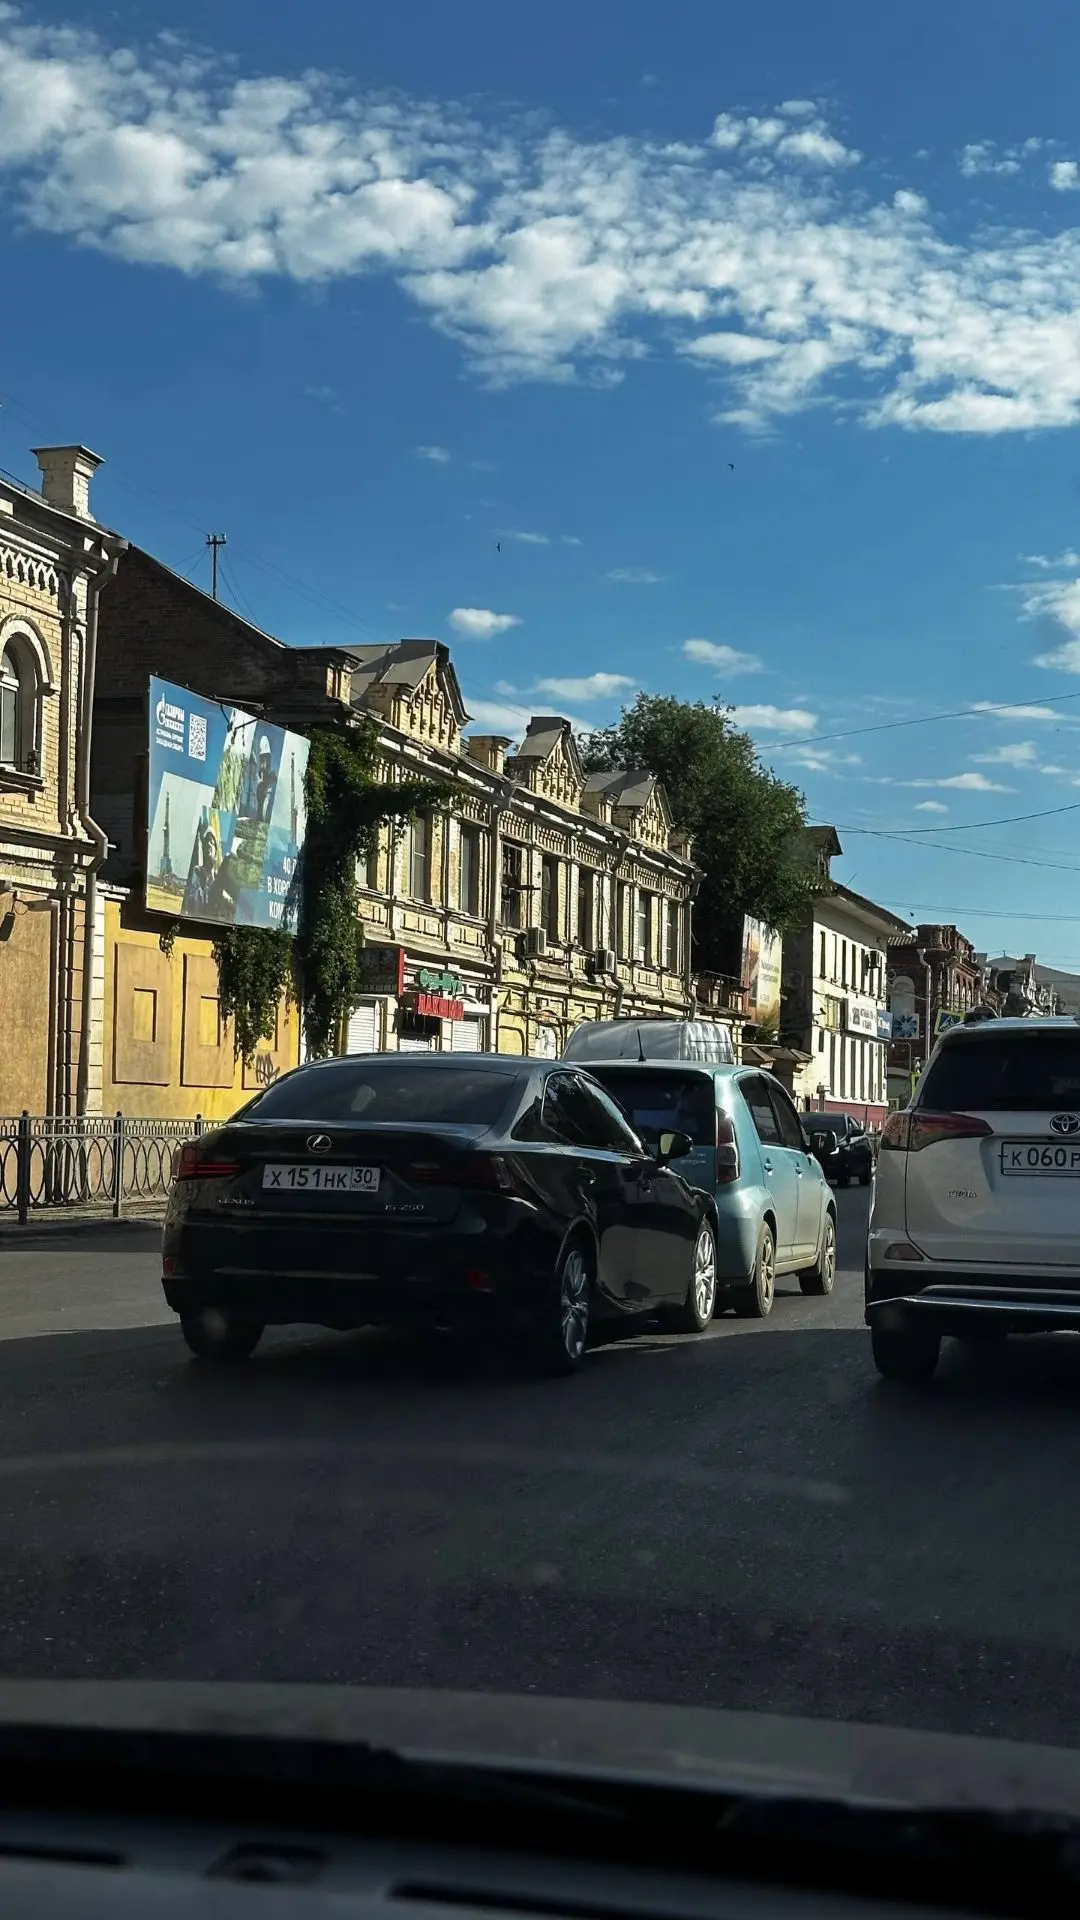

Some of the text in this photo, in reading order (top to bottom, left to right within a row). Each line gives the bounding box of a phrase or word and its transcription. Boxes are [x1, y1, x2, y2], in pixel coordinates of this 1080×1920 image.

[418, 993, 464, 1020] ЛАКШМИ
[354, 1169, 373, 1184] 30
[400, 1203, 425, 1211] 250
